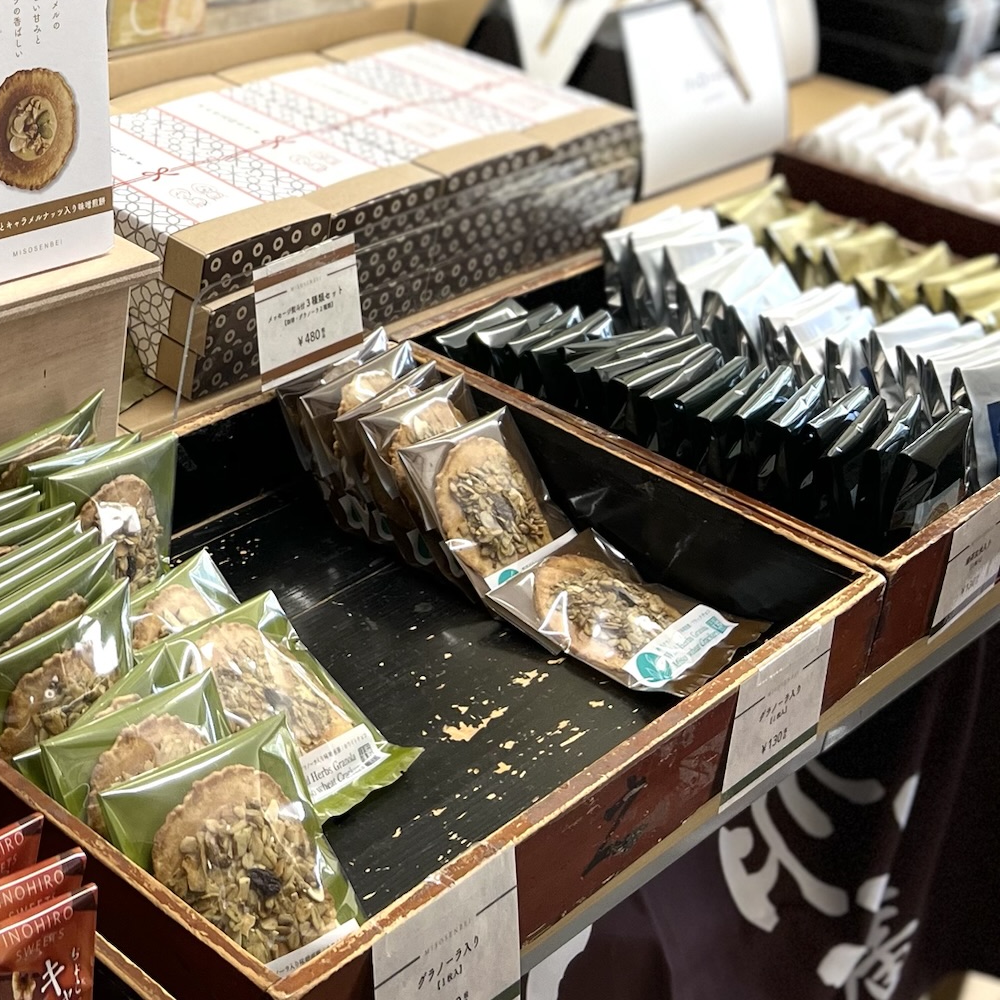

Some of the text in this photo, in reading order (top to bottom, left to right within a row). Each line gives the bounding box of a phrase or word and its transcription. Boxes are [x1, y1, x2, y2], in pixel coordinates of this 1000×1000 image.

[12, 239, 63, 257] MISOSENBEI
[1, 905, 74, 948] INOHIRO
[16, 927, 65, 962] SWEETS
[417, 935, 480, 991] グラノーラ入り
